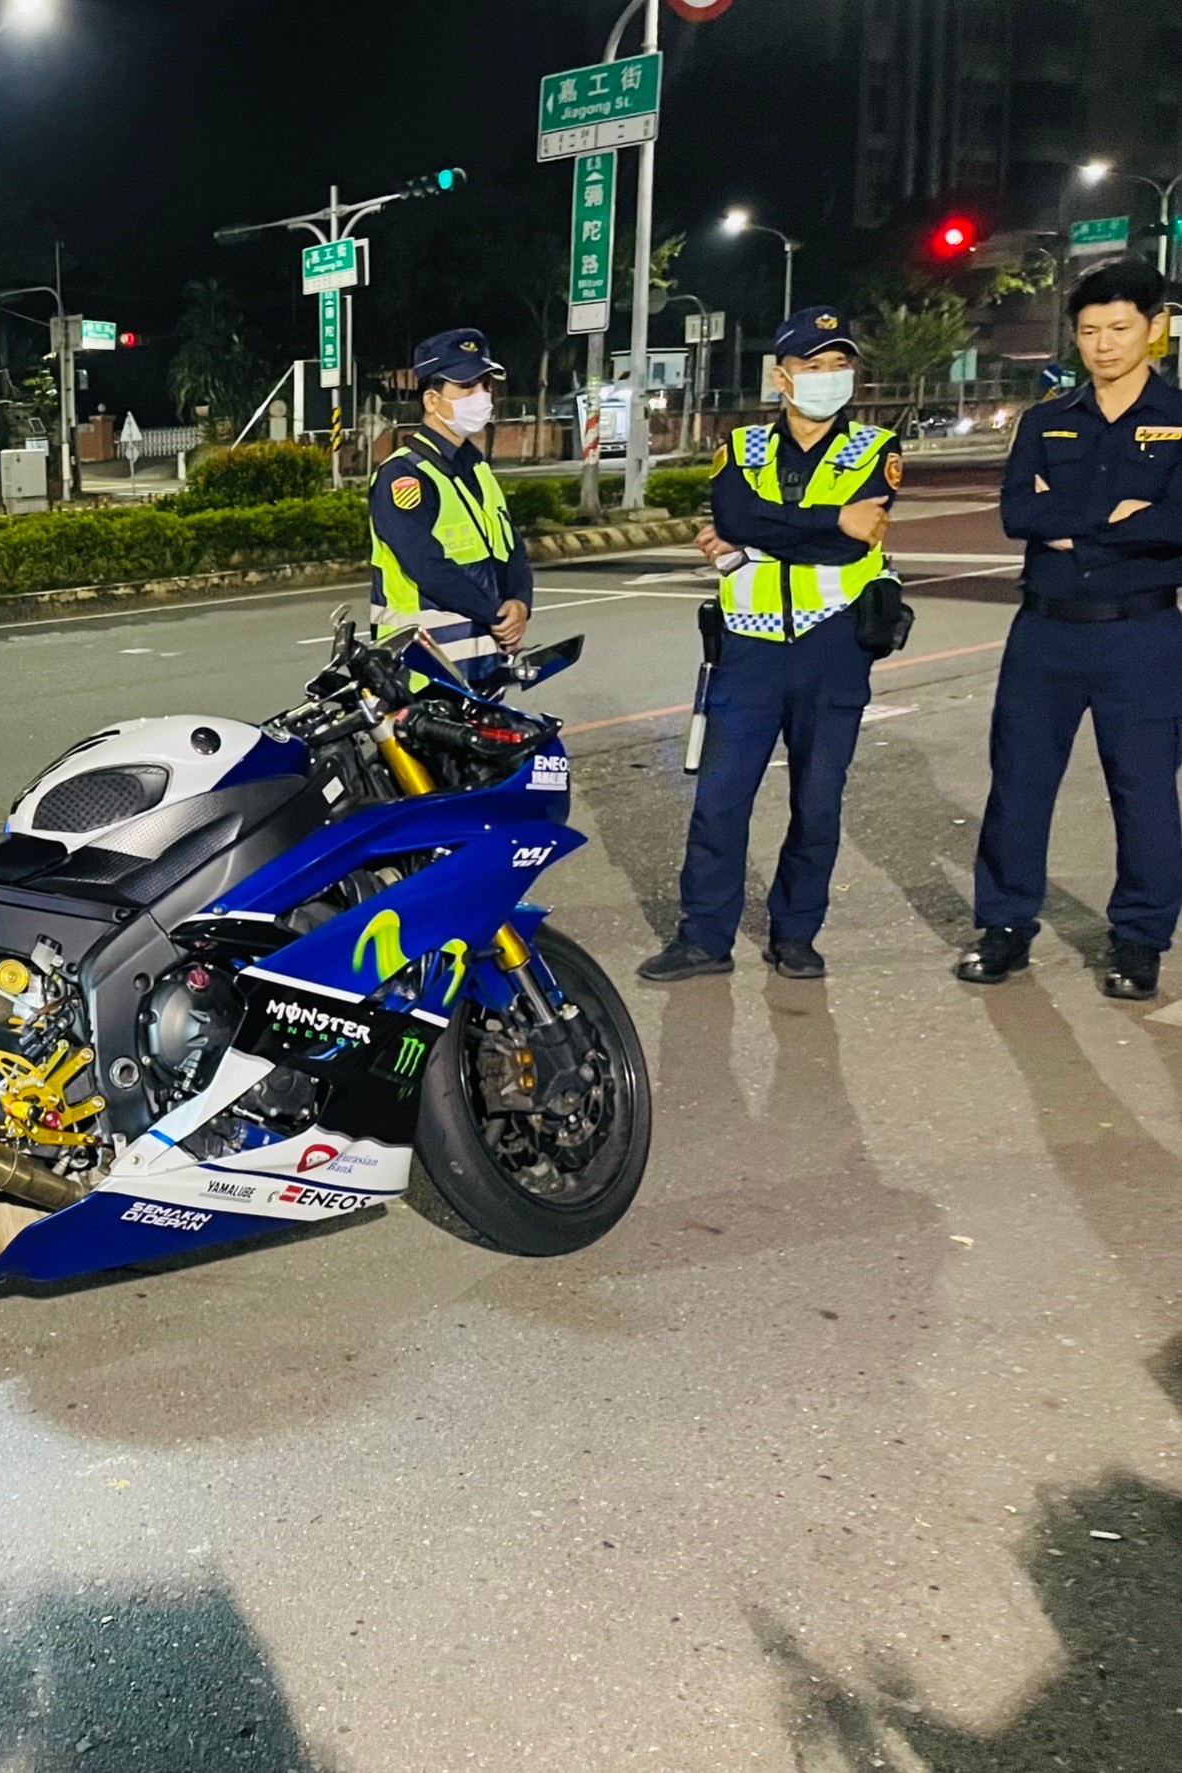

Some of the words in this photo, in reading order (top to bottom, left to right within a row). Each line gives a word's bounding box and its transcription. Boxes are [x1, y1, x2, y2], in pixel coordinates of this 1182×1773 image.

[558, 64, 643, 105] 嘉工街
[533, 755, 569, 771] ENEO
[266, 999, 371, 1044] MONSTER
[272, 1023, 360, 1048] ENERGY
[326, 1161, 355, 1175] Bank
[335, 1152, 379, 1167] Eurasian
[207, 1180, 256, 1198] YAMALUBE
[296, 1188, 372, 1211] ENEOS
[120, 1210, 143, 1222] DI
[140, 1213, 205, 1231] DEPAN
[129, 1201, 213, 1223] SEMAKIN
